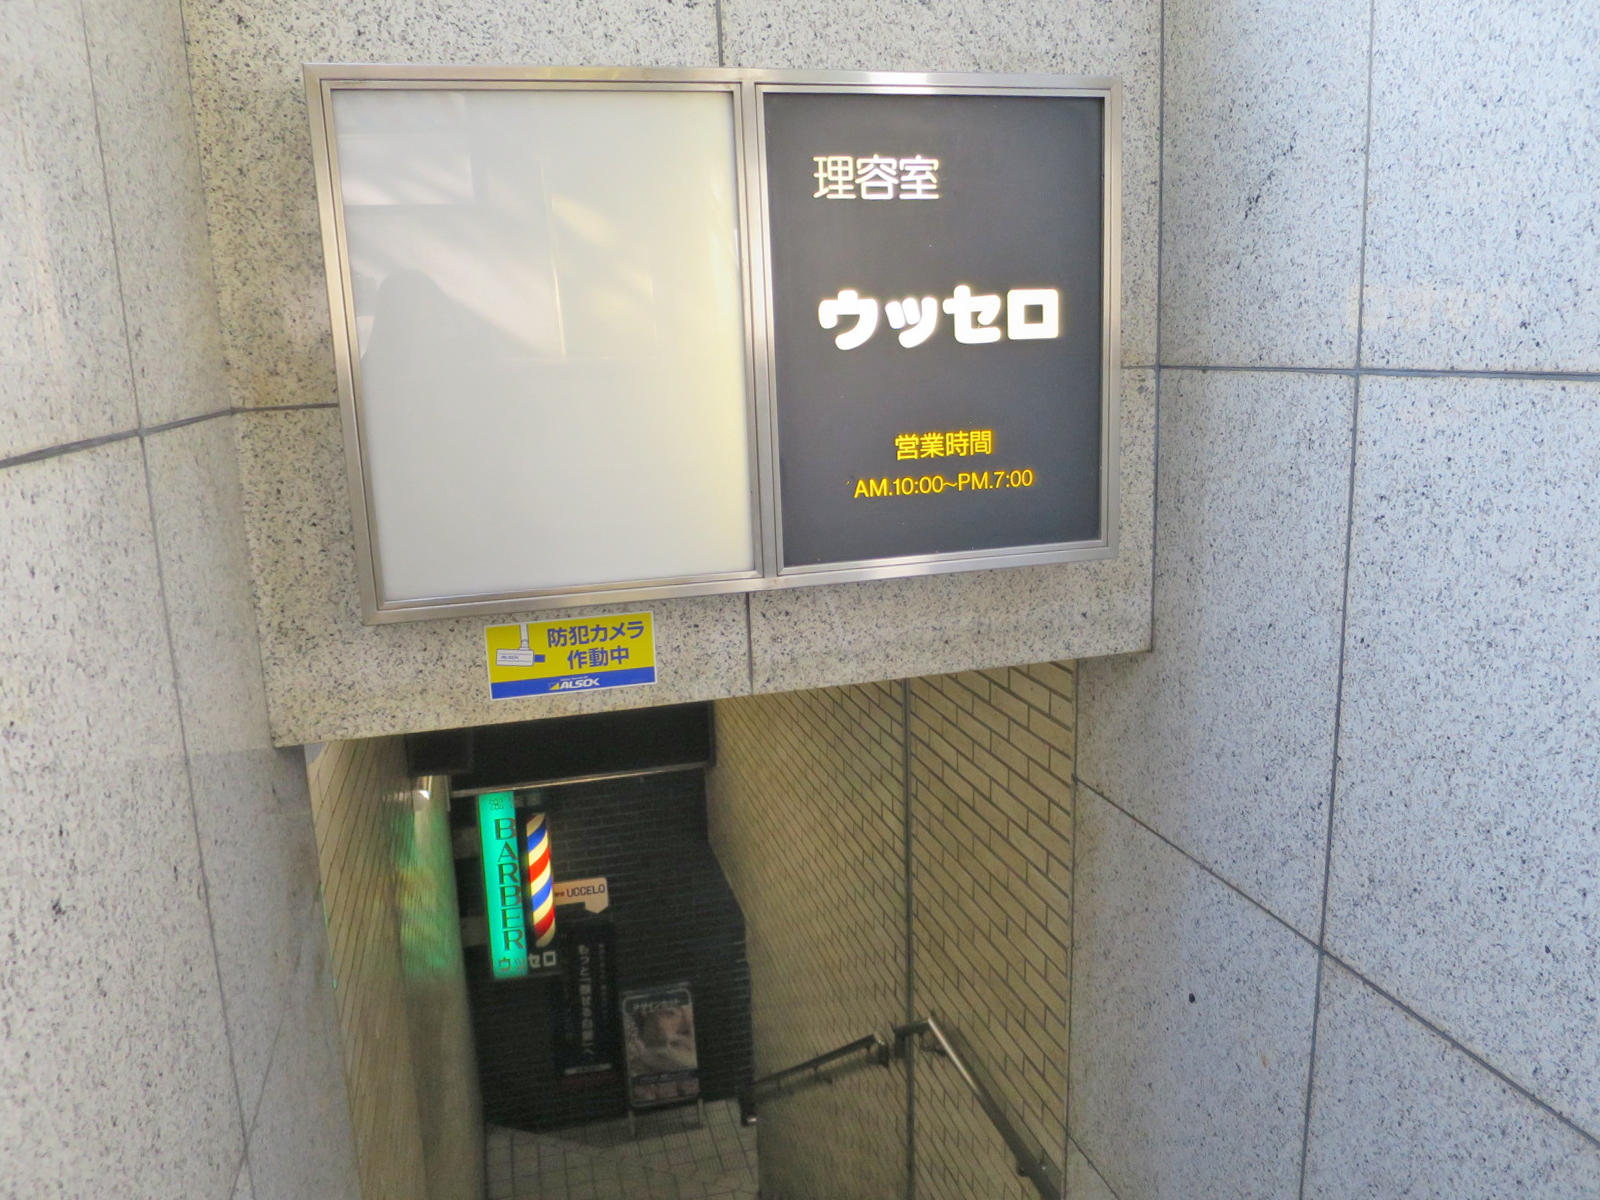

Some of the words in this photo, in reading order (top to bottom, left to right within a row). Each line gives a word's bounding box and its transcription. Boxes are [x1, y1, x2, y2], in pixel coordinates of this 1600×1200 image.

[813, 154, 940, 200] 理容室
[818, 284, 1059, 351] ウッセロ
[894, 429, 992, 461] 営業時間
[547, 620, 645, 648] 防犯カメラ
[567, 645, 630, 670] 作動中
[559, 677, 600, 690] ALSOK
[494, 817, 526, 951] BARBER
[566, 883, 606, 898] UCCELO
